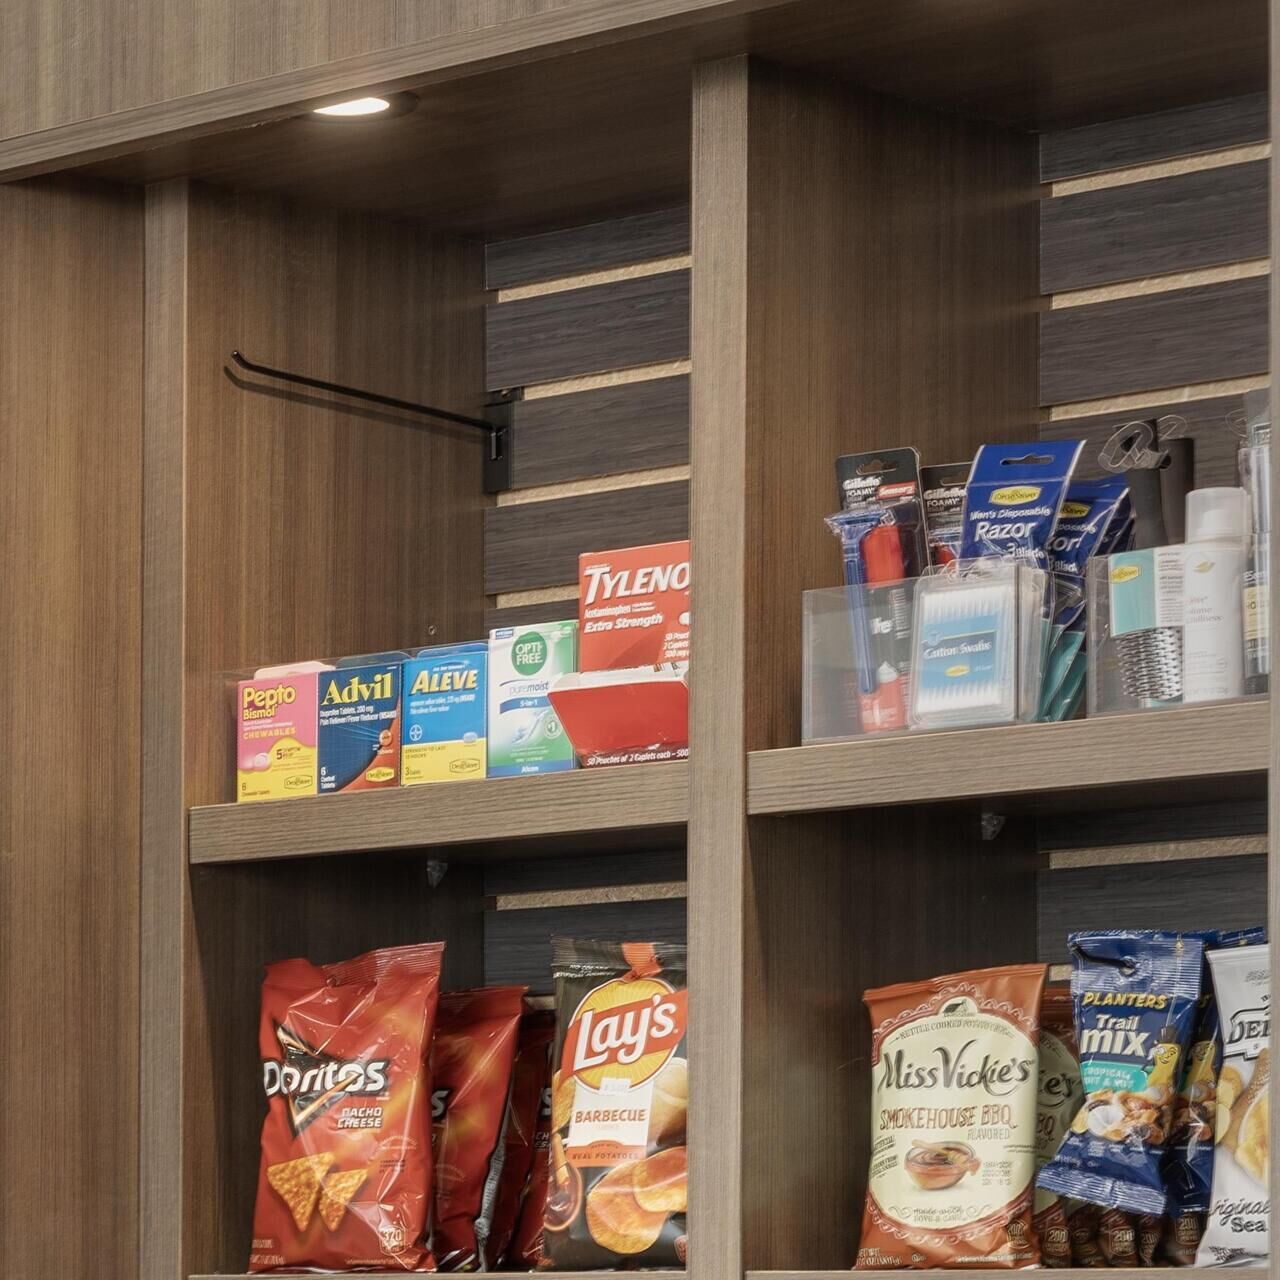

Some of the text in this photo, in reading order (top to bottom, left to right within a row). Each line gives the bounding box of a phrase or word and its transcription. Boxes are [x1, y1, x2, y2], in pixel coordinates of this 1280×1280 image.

[845, 487, 874, 498] FOAMY
[927, 498, 957, 508] FOAMY
[969, 506, 1053, 521] Men's Disposable
[974, 521, 1039, 543] Razor
[583, 612, 664, 634] Extra Strength
[516, 652, 542, 666] FREE
[320, 672, 394, 707] Advil
[411, 669, 479, 696] ALEVE
[509, 679, 550, 694] puremoist
[242, 685, 297, 714] Pepto
[242, 706, 278, 721] Bismol
[243, 728, 297, 740] CHEWABLES
[276, 749, 283, 760] 5
[634, 753, 658, 764] Caplets
[658, 752, 671, 761] each
[320, 766, 327, 776] 6
[1081, 992, 1168, 1010] PLANTERS
[899, 1020, 963, 1040] KETTLE COOKED
[1095, 1013, 1140, 1031] Trail
[573, 993, 679, 1073] Lay's
[1079, 1028, 1151, 1058] mix
[877, 1038, 1036, 1097] Miss Vickie's
[263, 1059, 390, 1097] Doritos
[341, 1106, 383, 1118] NACHO
[574, 1108, 648, 1124] BARBECUE
[879, 1104, 1019, 1131] SMOKEHOUSE BBQ
[337, 1116, 383, 1130] CHEESE
[967, 1128, 1011, 1141] FLAVORED
[1230, 1217, 1268, 1233] Sea
